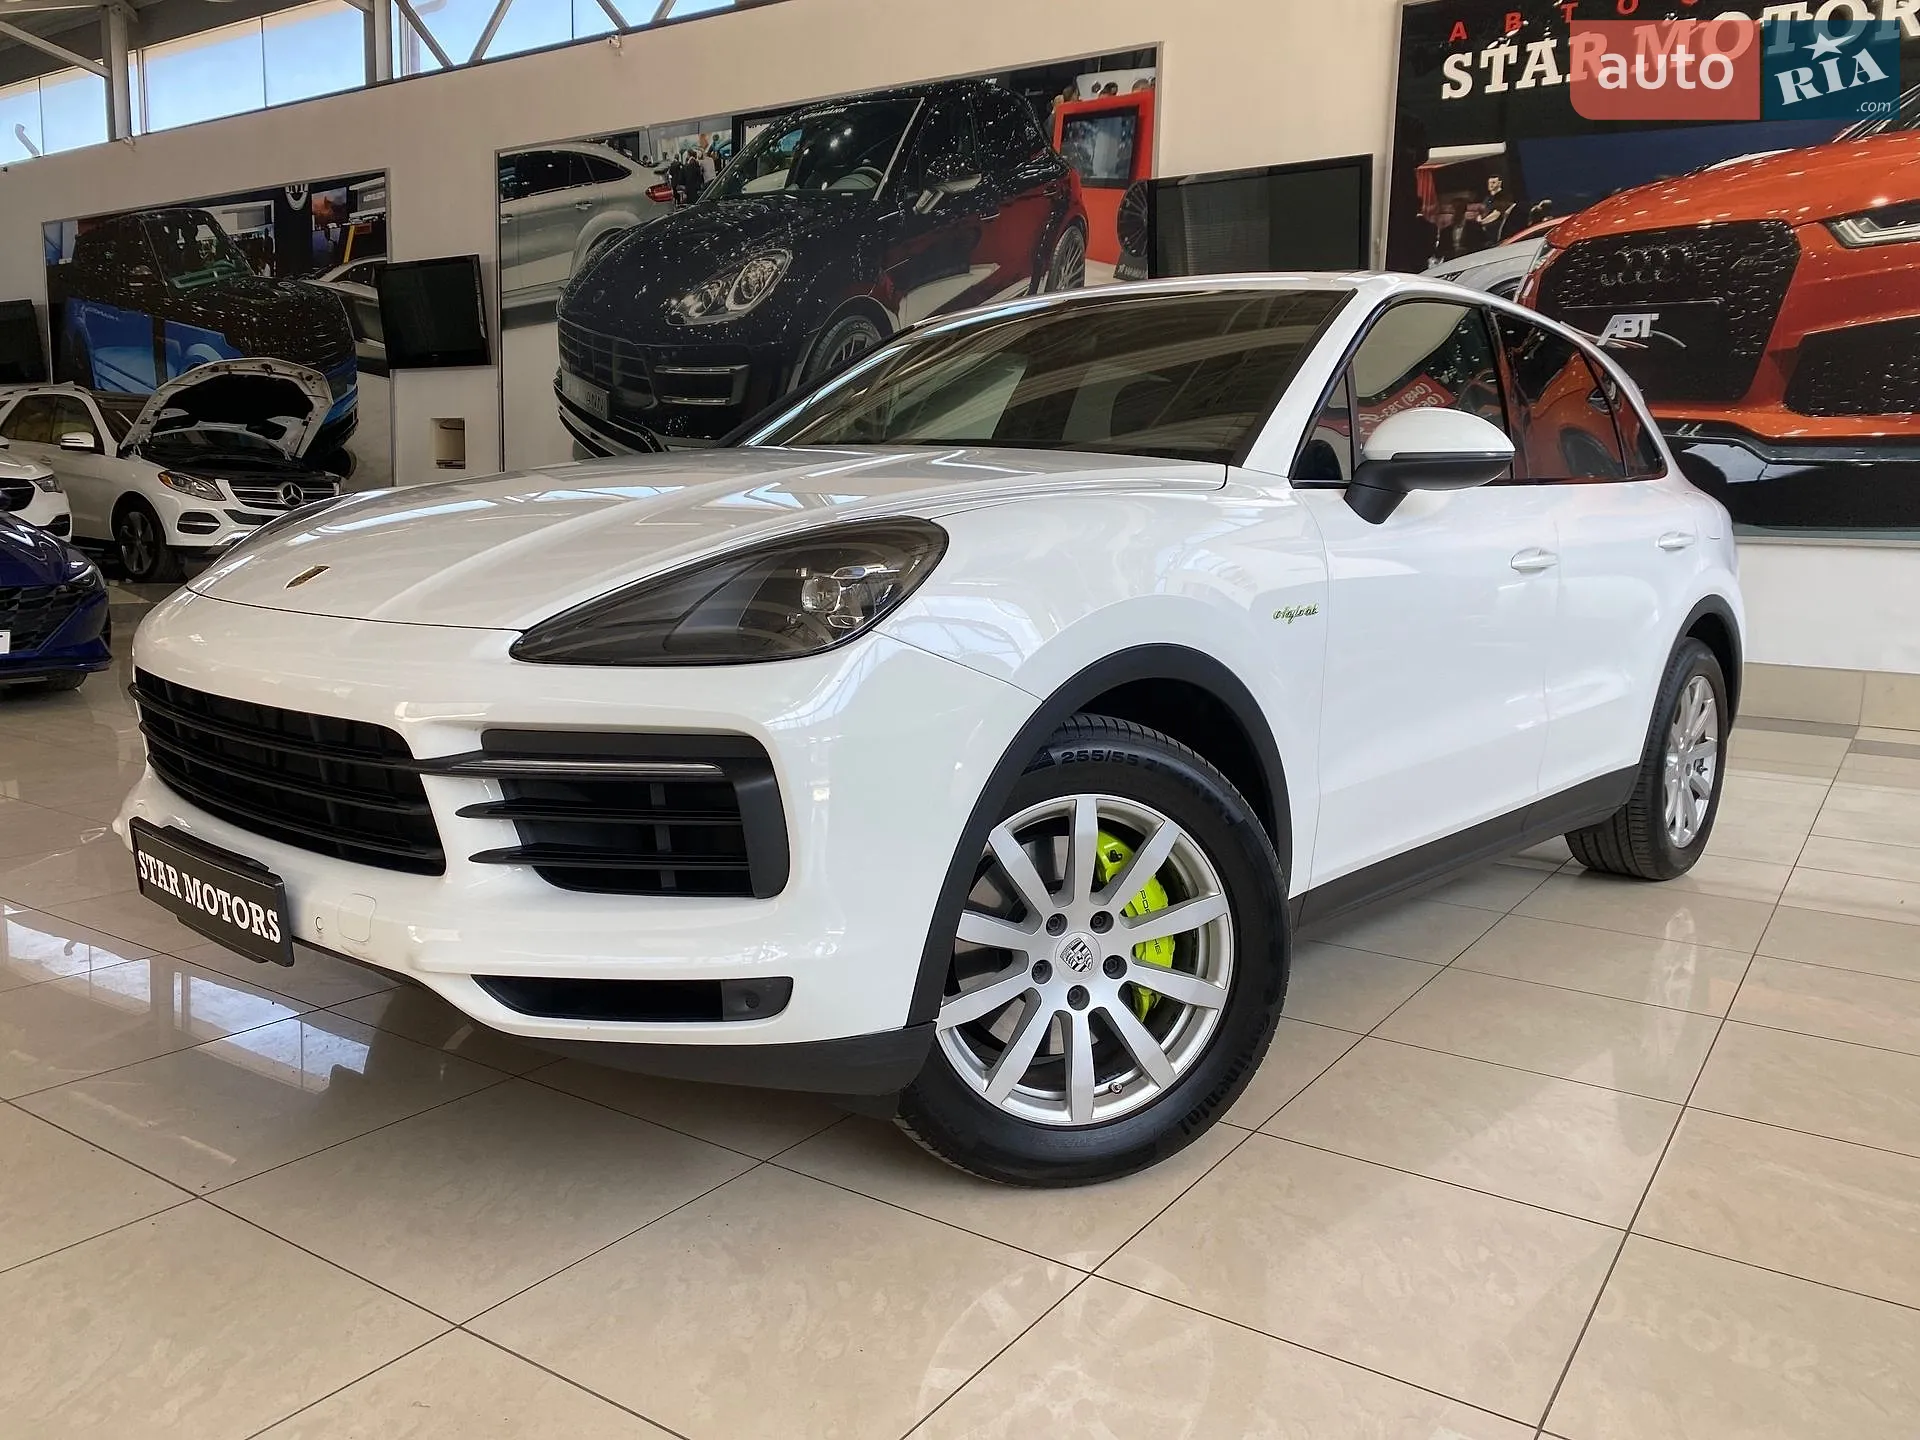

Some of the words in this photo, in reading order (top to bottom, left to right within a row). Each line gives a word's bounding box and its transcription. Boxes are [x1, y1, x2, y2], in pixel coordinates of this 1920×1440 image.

[1441, 30, 1608, 100] STAR
[1596, 313, 1660, 346] ABT
[1061, 749, 1139, 767] 255/55
[138, 849, 182, 899] STAR
[181, 872, 281, 944] MOTORS
